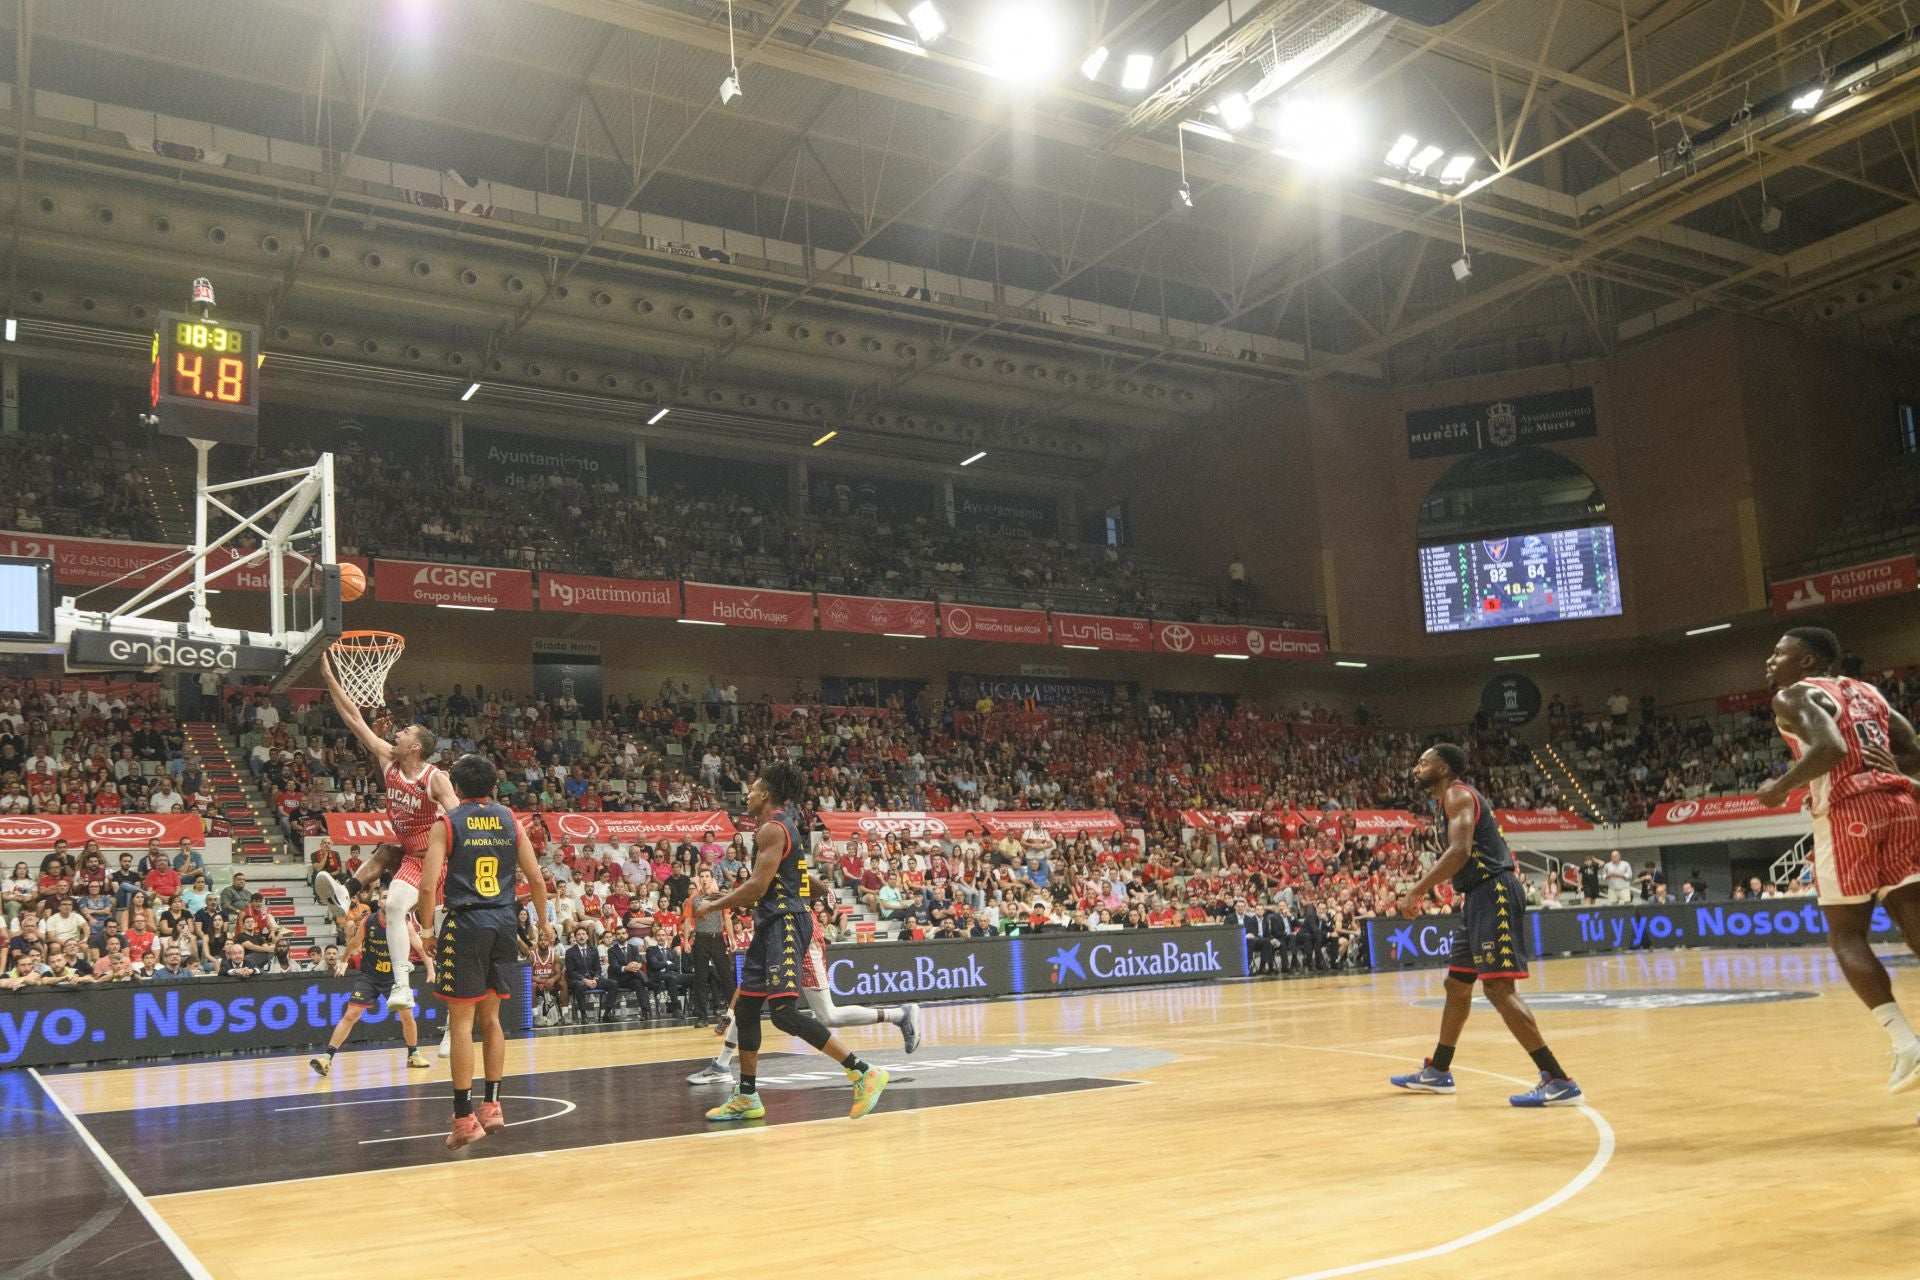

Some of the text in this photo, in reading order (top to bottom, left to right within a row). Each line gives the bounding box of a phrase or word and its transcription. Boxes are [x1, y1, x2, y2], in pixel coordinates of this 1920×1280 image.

[177, 353, 243, 403] 4.8
[1520, 407, 1592, 424] Ayuntamiento
[1536, 420, 1576, 433] Murcia
[60, 553, 76, 565] V2
[430, 567, 496, 589] caser
[1490, 568, 1507, 583] 92
[1527, 564, 1545, 579] 64
[1832, 566, 1891, 587] Asterra
[413, 589, 498, 605] Grupo Helvetia
[574, 584, 671, 605] patrimonial
[1831, 579, 1902, 601] Partners
[763, 612, 788, 625] viajes
[110, 638, 237, 670] endesa
[535, 641, 597, 652] Grada Norte
[1200, 634, 1320, 653] LABASA dama
[387, 788, 422, 809] UCAM
[97, 824, 154, 836] Juver
[467, 816, 502, 830] GANAL
[675, 824, 723, 832] MURCIA
[475, 856, 500, 897] 8
[1420, 926, 1454, 956] Cai
[1577, 913, 1605, 942] Tú
[1612, 916, 1625, 948] y
[1631, 914, 1684, 947] yo.
[1089, 939, 1222, 979] CaixaBank
[828, 953, 987, 997] CaixaBank
[0, 1006, 106, 1065] yo.
